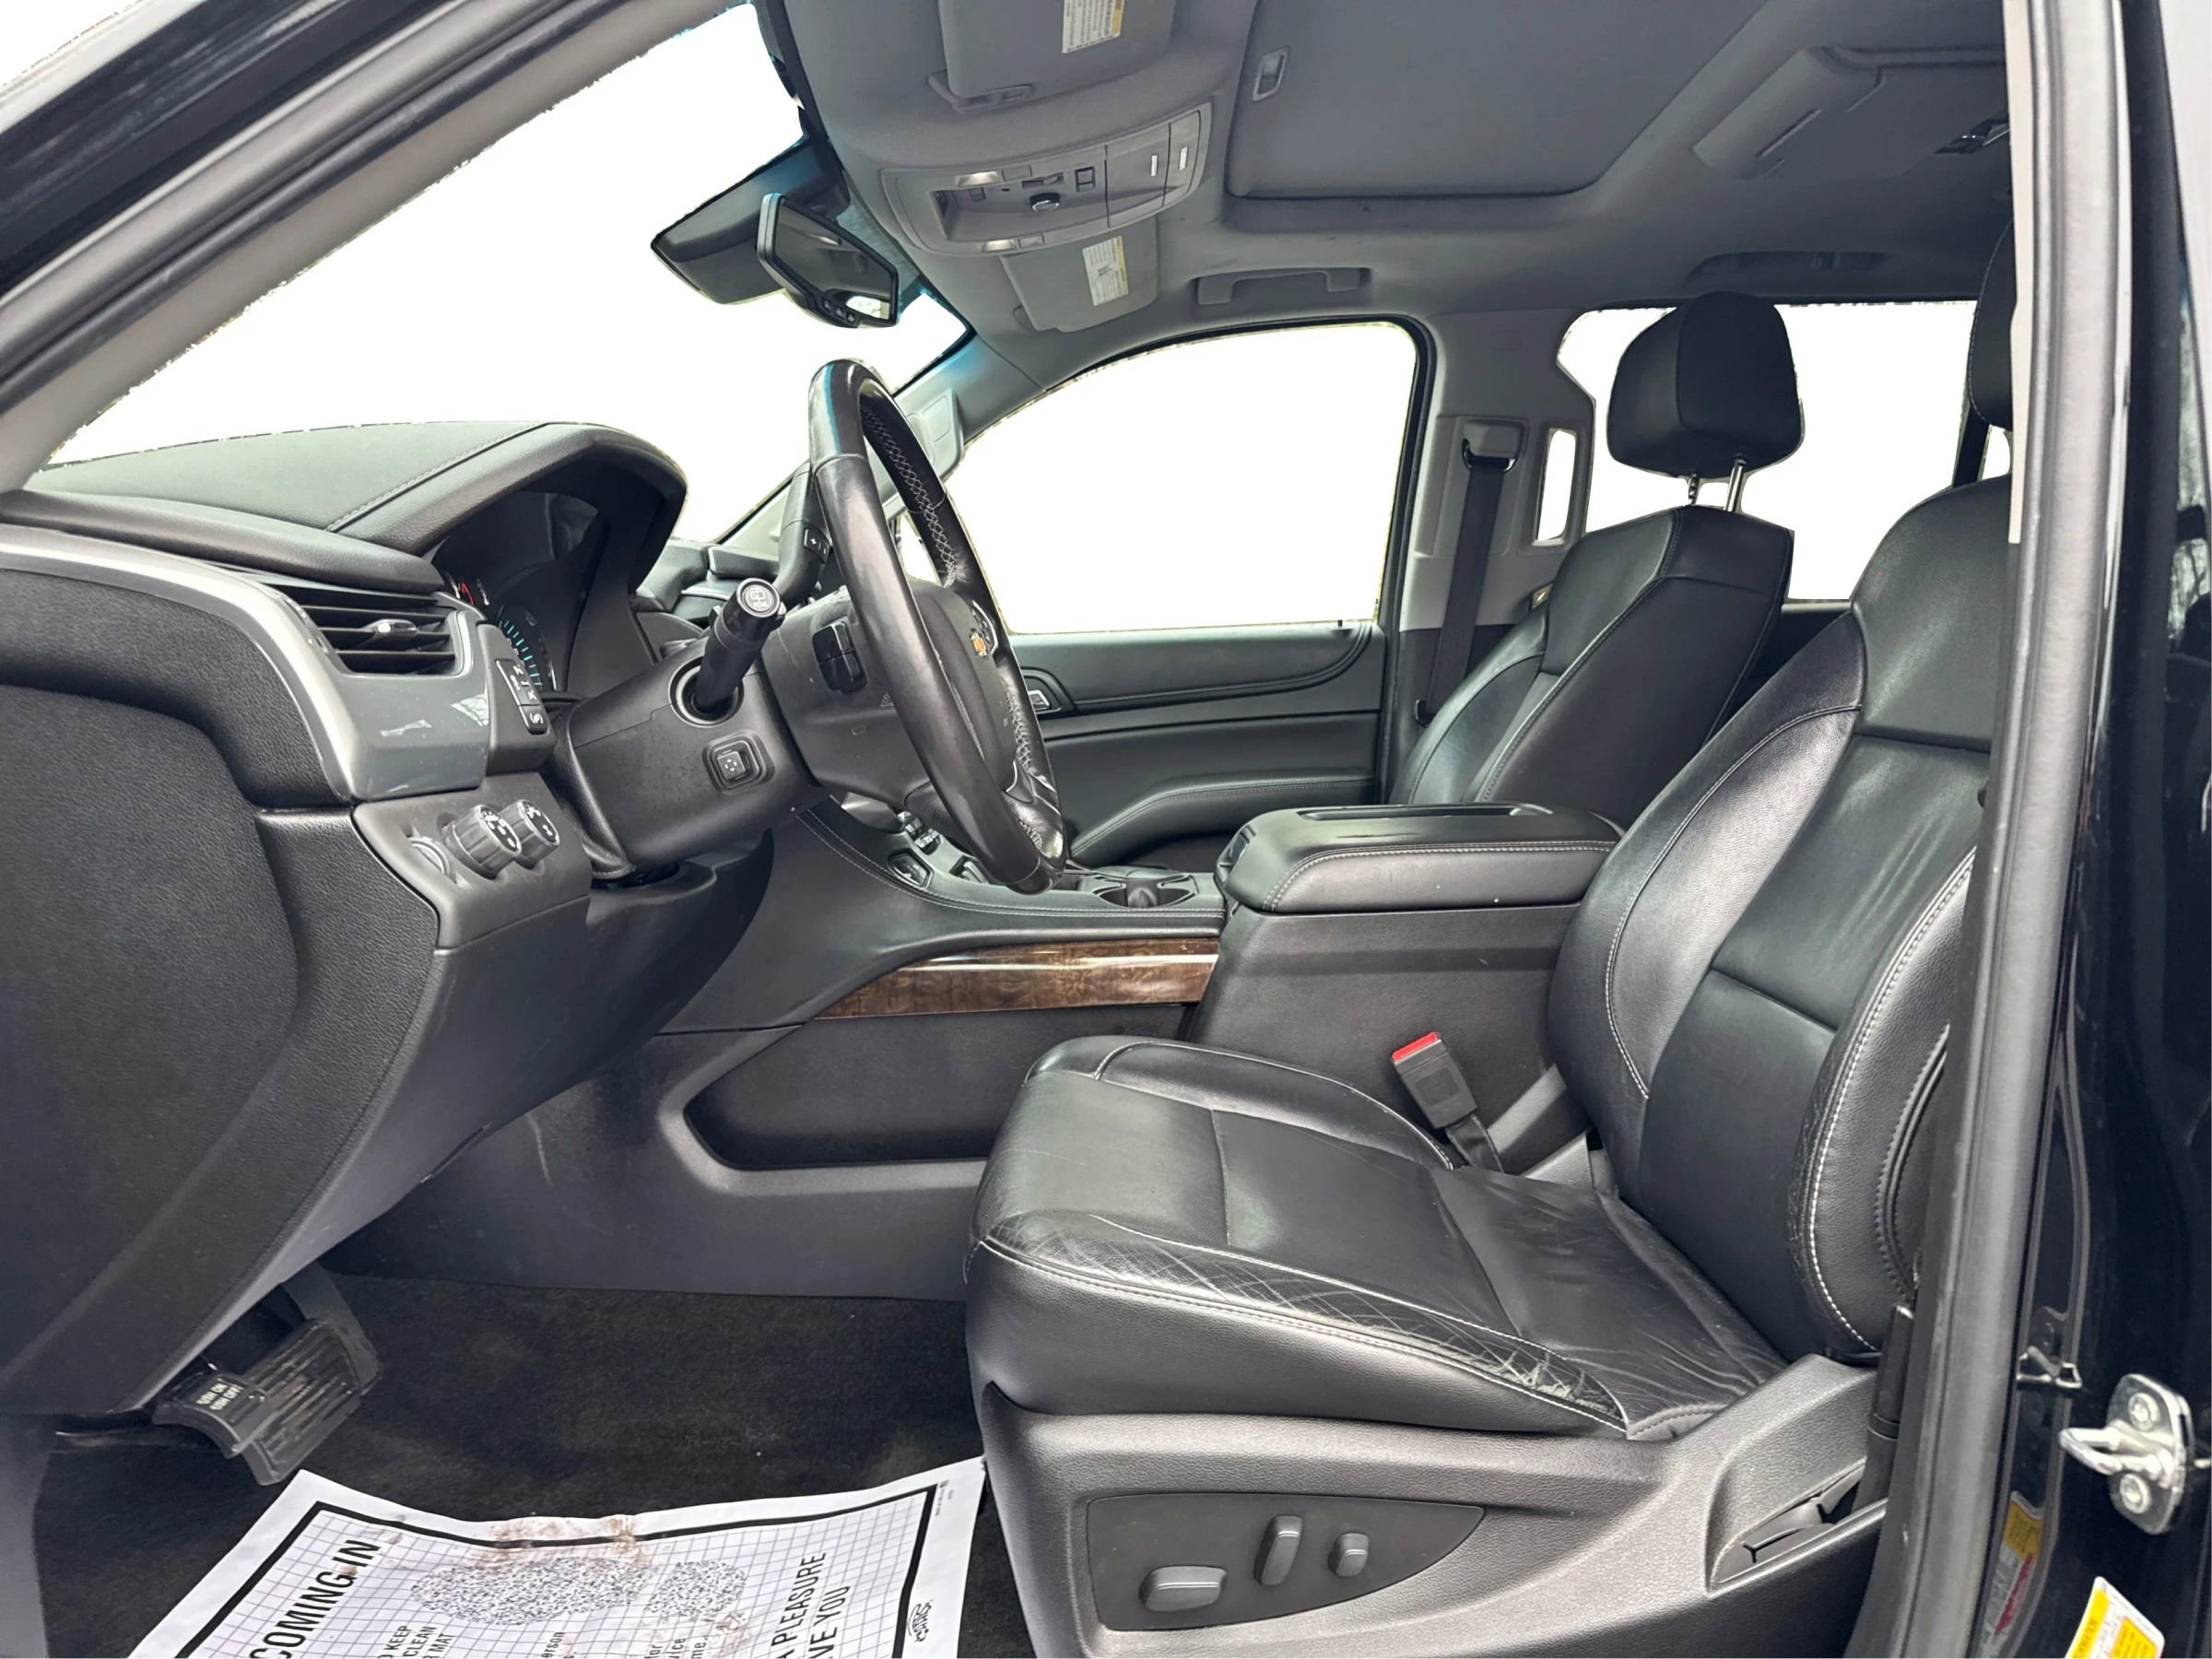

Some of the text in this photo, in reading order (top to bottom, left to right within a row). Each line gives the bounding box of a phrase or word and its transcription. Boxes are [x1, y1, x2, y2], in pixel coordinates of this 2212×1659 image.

[250, 1539, 381, 1659] COMING IN
[771, 1552, 826, 1647] PLEASURE
[813, 1586, 851, 1627] YOU
[385, 1625, 411, 1652] KEEP
[403, 1626, 437, 1658] CLEAN
[434, 1633, 455, 1654] MAT
